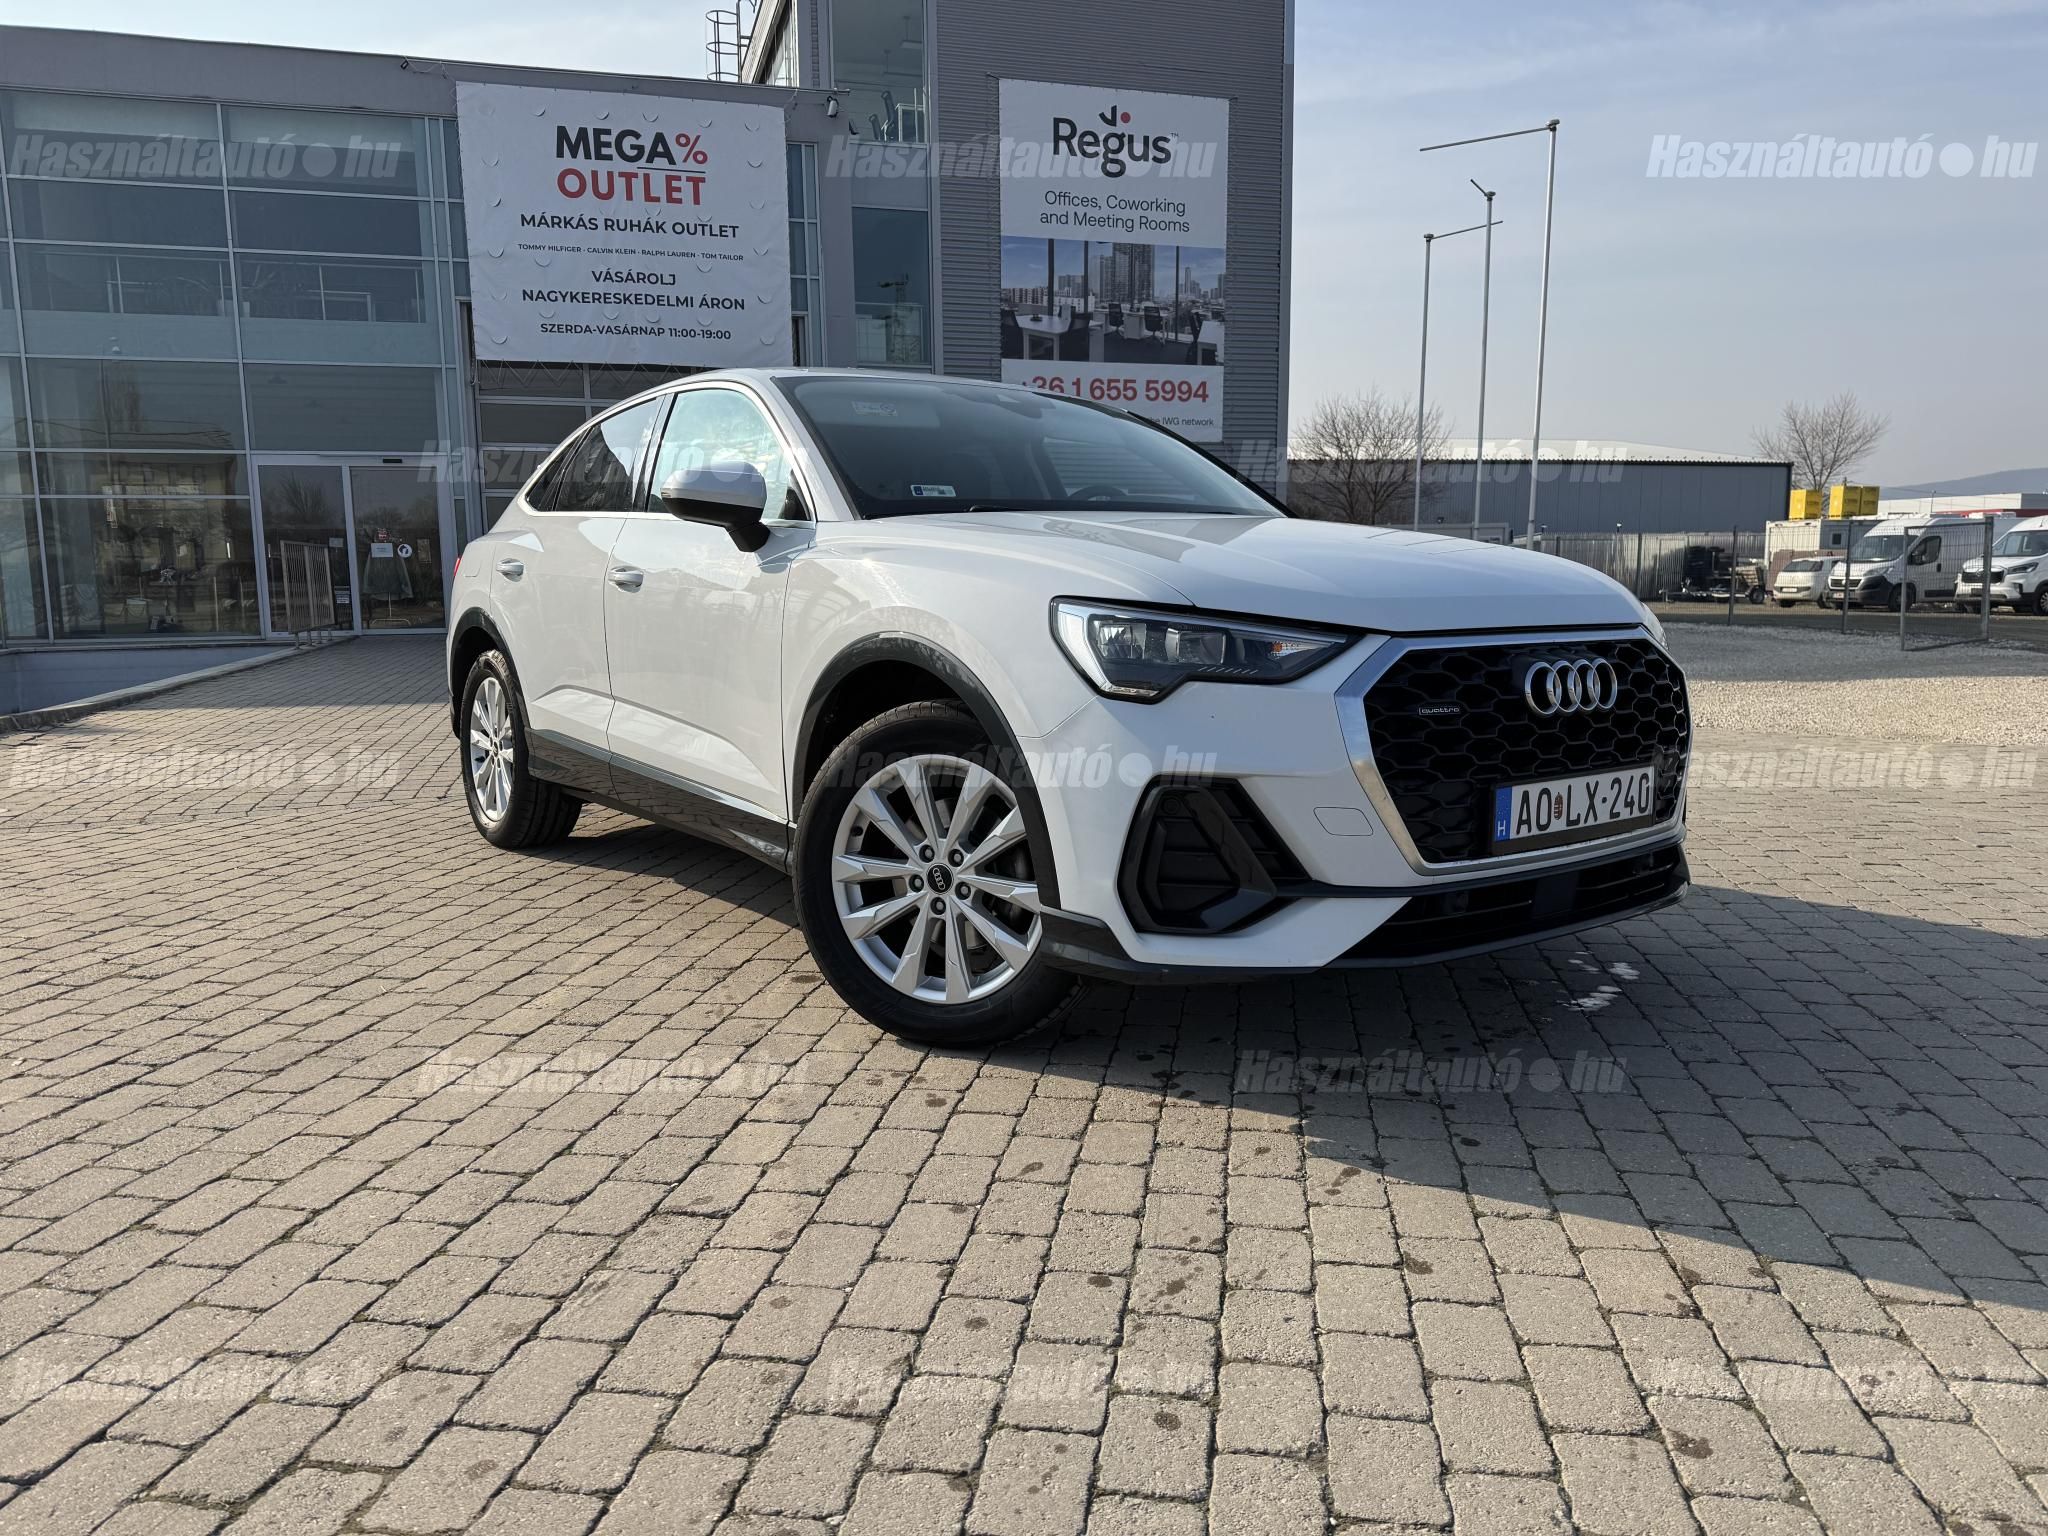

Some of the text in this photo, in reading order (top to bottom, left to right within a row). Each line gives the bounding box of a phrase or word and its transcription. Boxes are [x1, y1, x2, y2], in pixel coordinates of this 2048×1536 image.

[556, 125, 708, 166] MEGA%
[557, 168, 706, 205] OUTLET
[1044, 190, 1186, 217] Offices, Coworking
[520, 212, 739, 238] MÁRKÁS RUHÁK OUTLET
[1040, 211, 1190, 232] and Meeting Rooms
[518, 243, 546, 251] TOMMY
[548, 245, 582, 253] HILFIGER
[587, 247, 613, 255] CALVIN
[641, 249, 665, 257] RALPH
[667, 251, 696, 259] LAUREN
[718, 253, 744, 261] TAILOR
[591, 268, 676, 286] VÁSÁROLJ
[522, 289, 745, 310] NAGYKERESKEDELMI ÁRON
[540, 323, 731, 340] SZERDA-VASÁRNAP 11:00-19:00
[1089, 377, 1137, 400] 655
[1145, 379, 1209, 403] 5994
[1162, 417, 1180, 425] IWG
[1182, 418, 1214, 426] network
